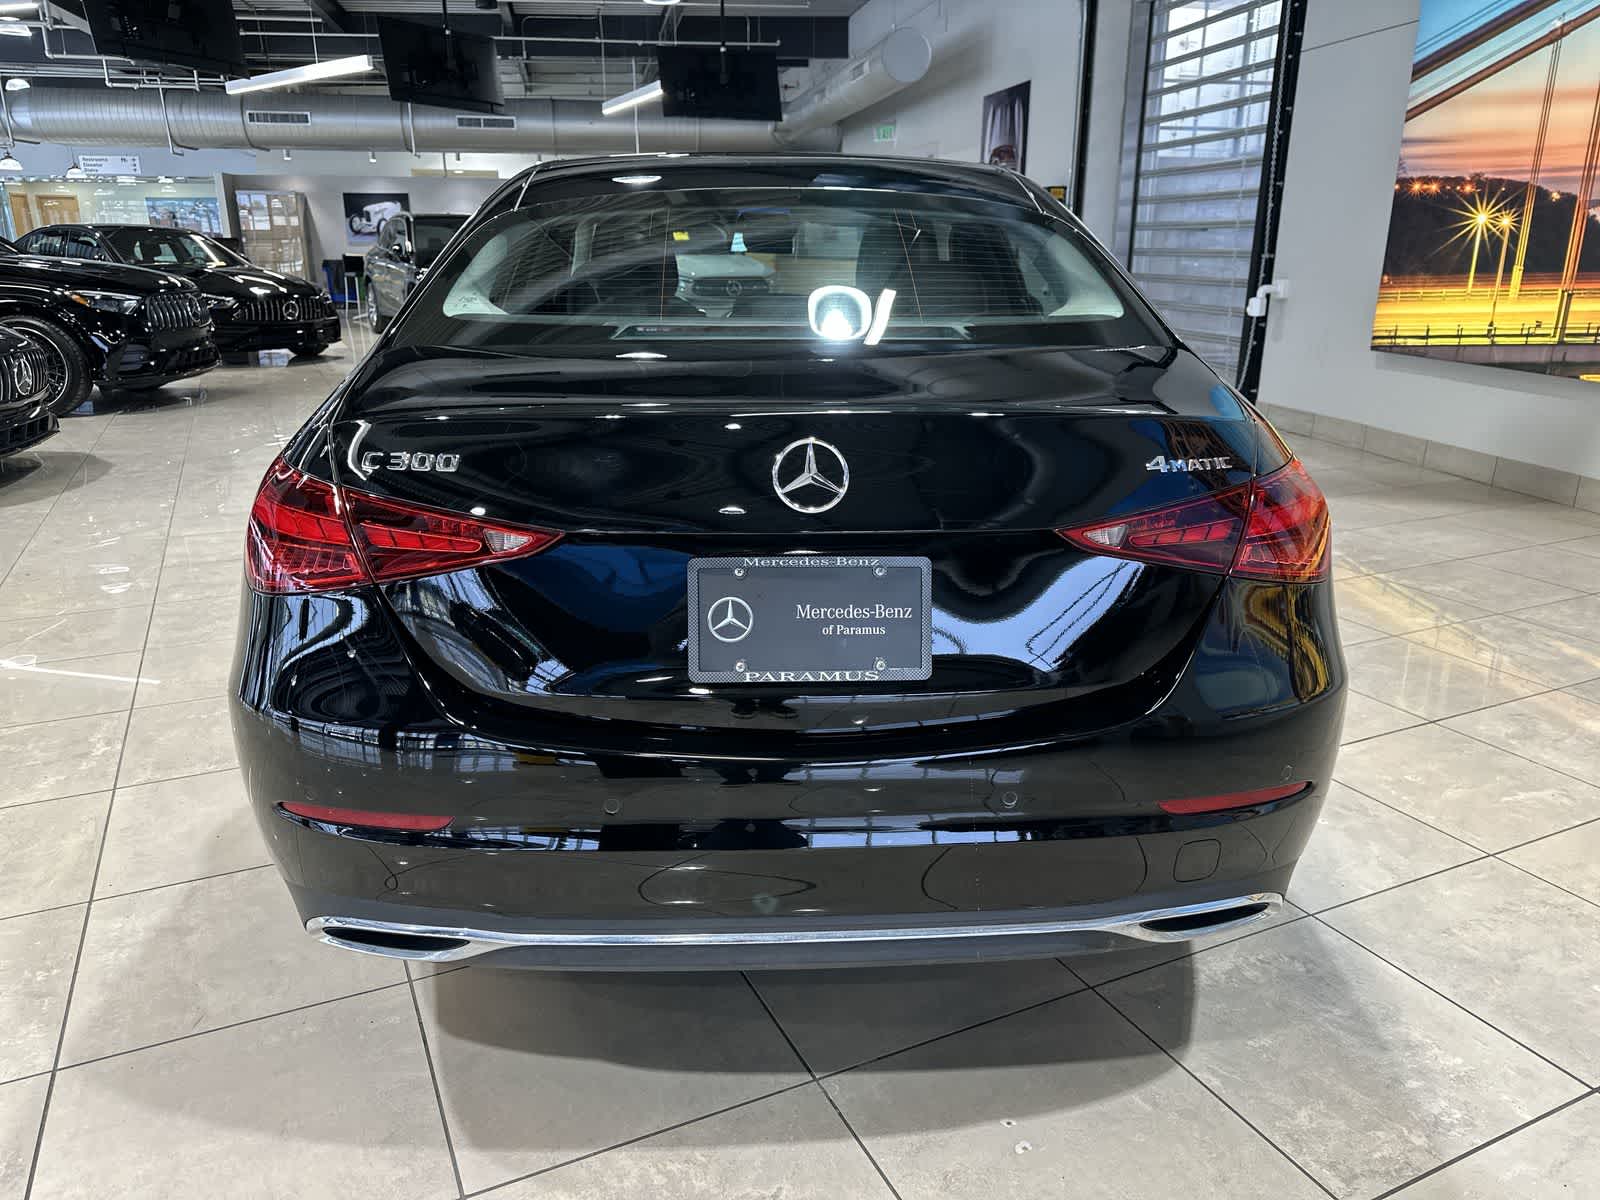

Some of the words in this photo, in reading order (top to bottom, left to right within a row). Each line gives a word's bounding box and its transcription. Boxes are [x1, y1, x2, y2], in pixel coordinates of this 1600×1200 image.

[361, 451, 384, 471] C
[386, 451, 460, 472] 300
[1145, 455, 1233, 473] 4MATIC
[743, 557, 881, 567] Mercedes-Benz
[796, 604, 912, 619] Mercedes-Benz
[822, 625, 834, 635] of
[836, 625, 886, 635] Paramus
[743, 670, 881, 682] PARAMUS
